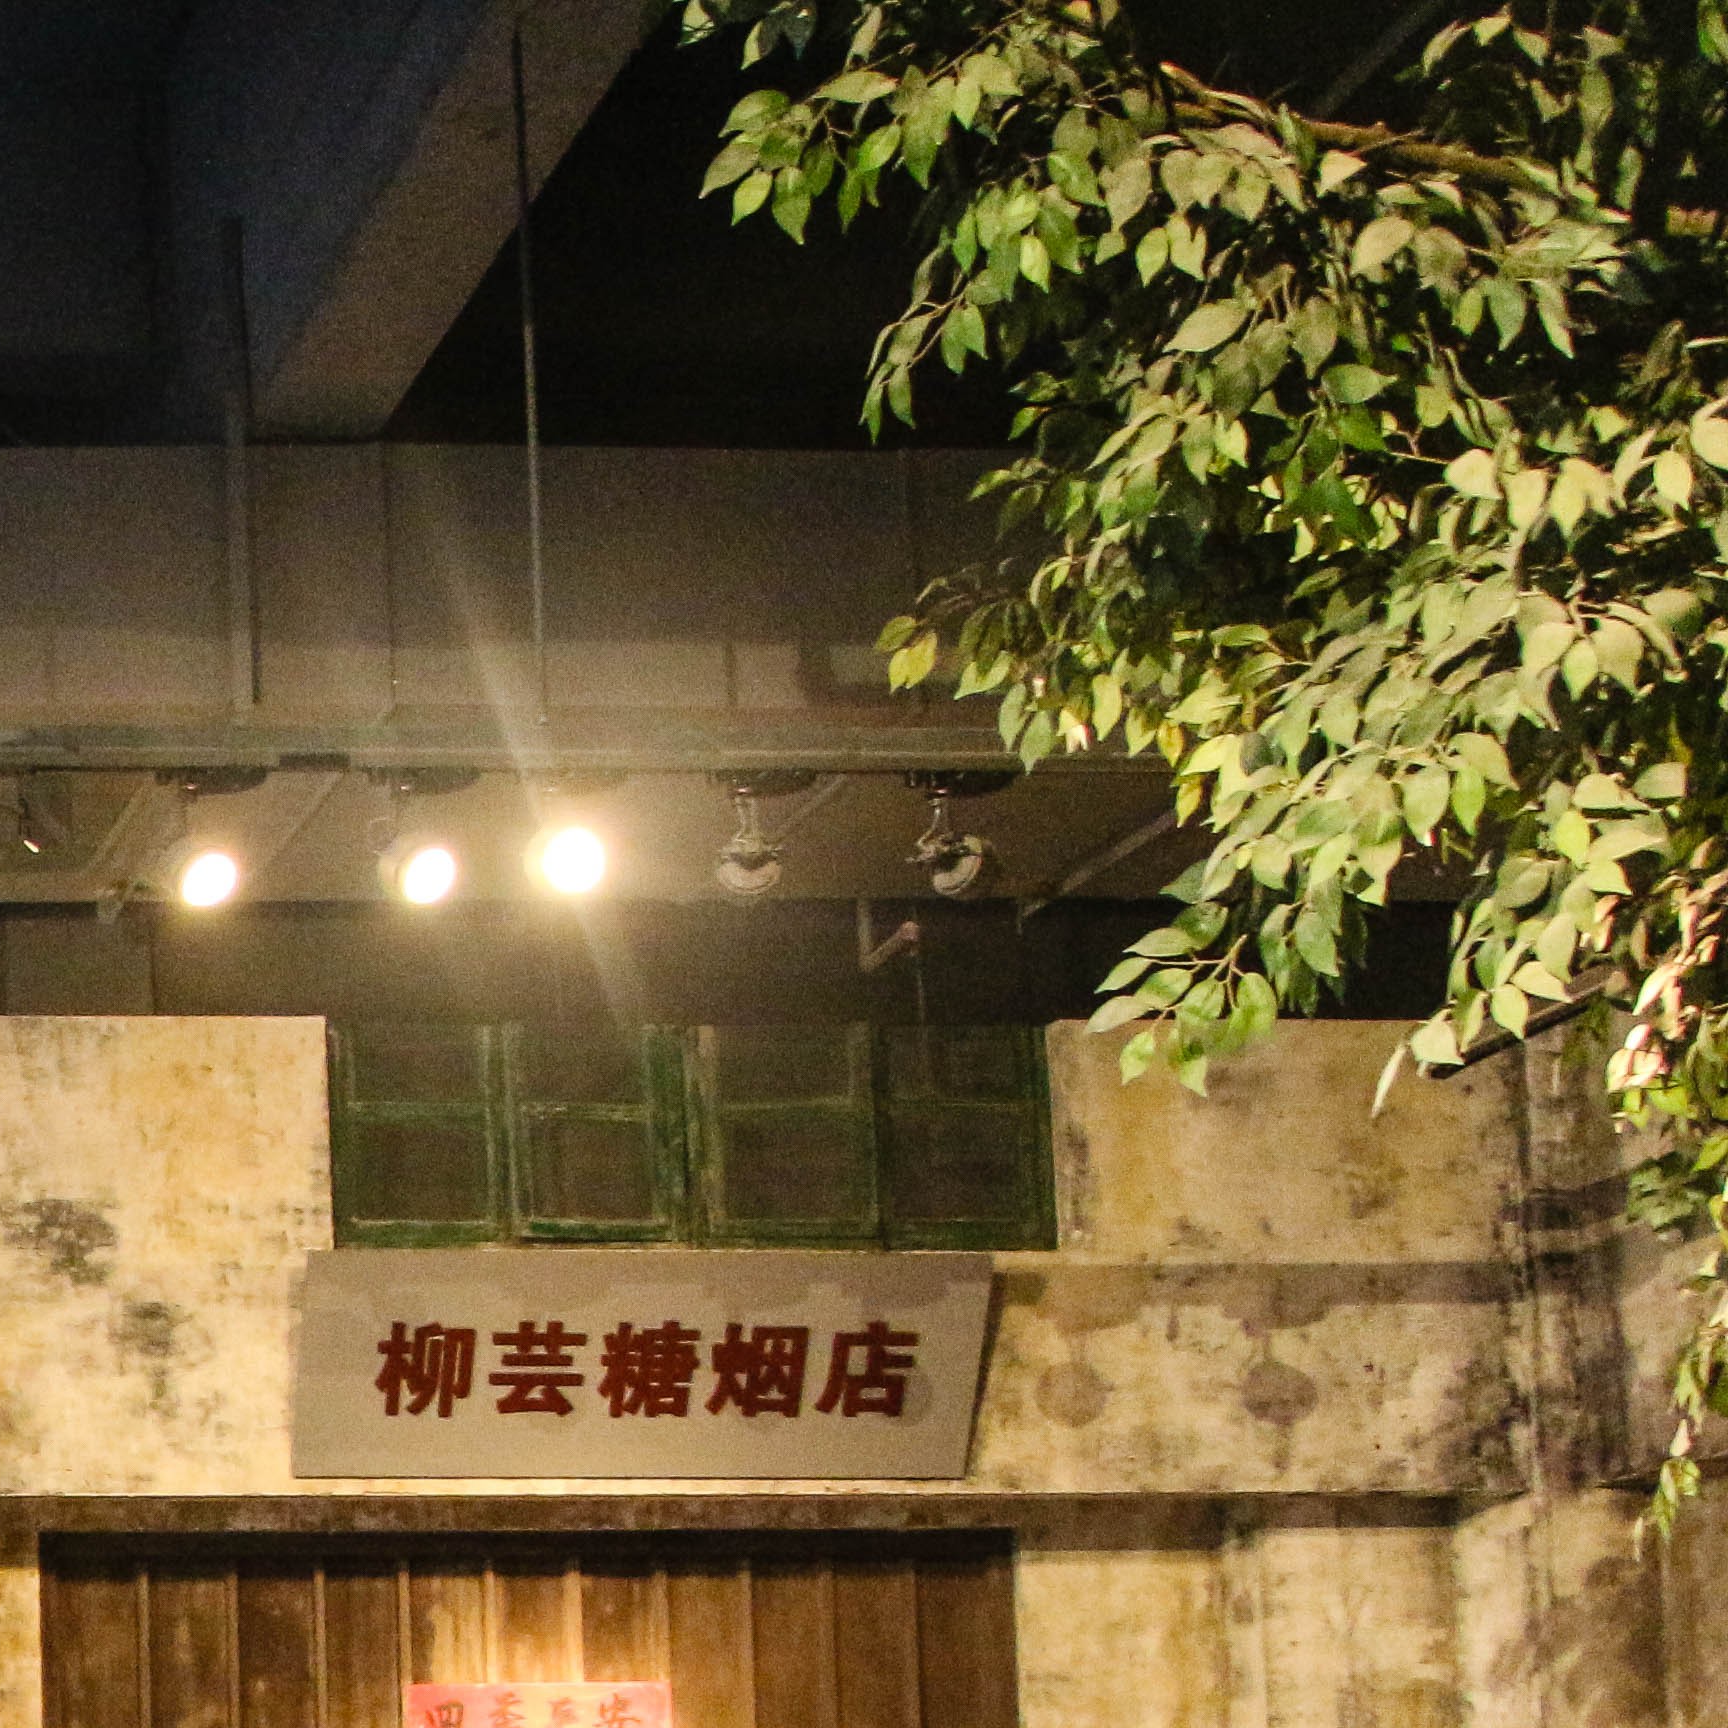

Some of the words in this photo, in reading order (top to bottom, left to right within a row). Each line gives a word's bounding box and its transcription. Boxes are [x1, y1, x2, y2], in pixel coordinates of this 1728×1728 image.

[375, 1320, 919, 1419] 柳芸糖烟店
